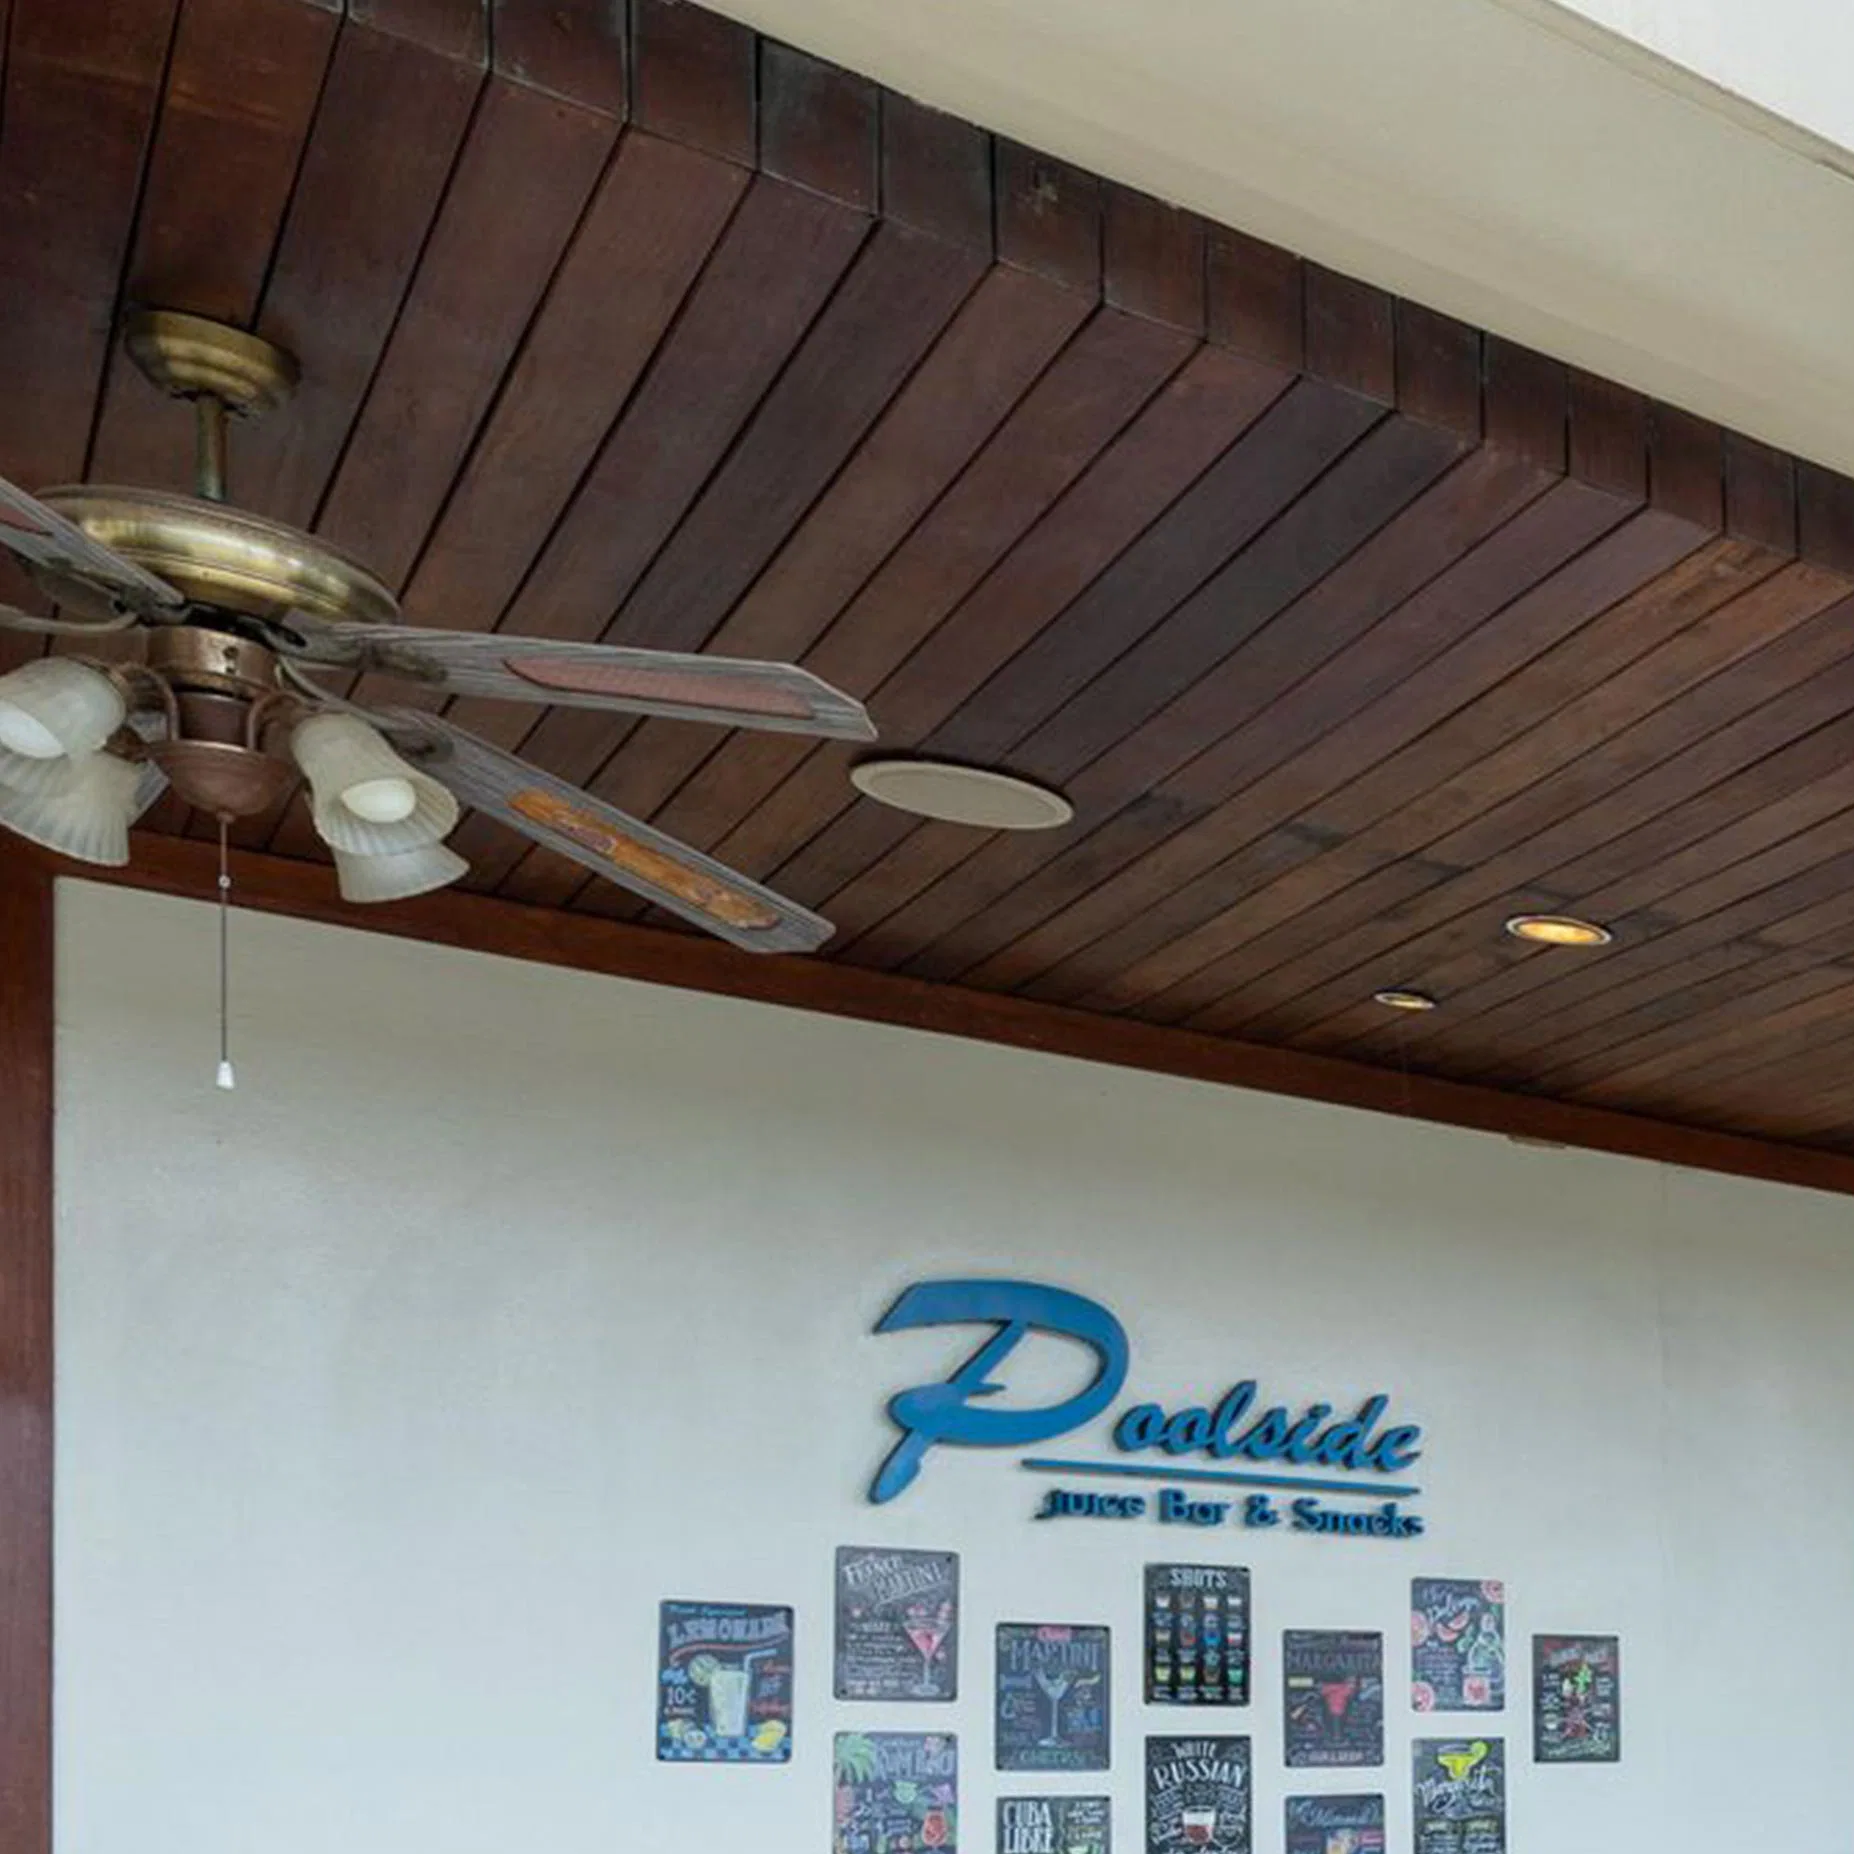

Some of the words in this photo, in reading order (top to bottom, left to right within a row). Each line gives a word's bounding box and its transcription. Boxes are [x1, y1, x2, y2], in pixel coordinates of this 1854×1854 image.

[868, 1278, 1424, 1504] Poolside
[1157, 1487, 1231, 1527] Bar
[1244, 1492, 1282, 1530] &
[1291, 1496, 1426, 1539] Snacks
[1169, 1567, 1228, 1589] SHOTS
[1010, 1639, 1100, 1671] MARTINI
[1170, 1740, 1217, 1759] WHITE
[1152, 1758, 1247, 1791] RUSSIAN
[1003, 1800, 1052, 1828] CUBA
[1003, 1827, 1054, 1854] LIBRE
